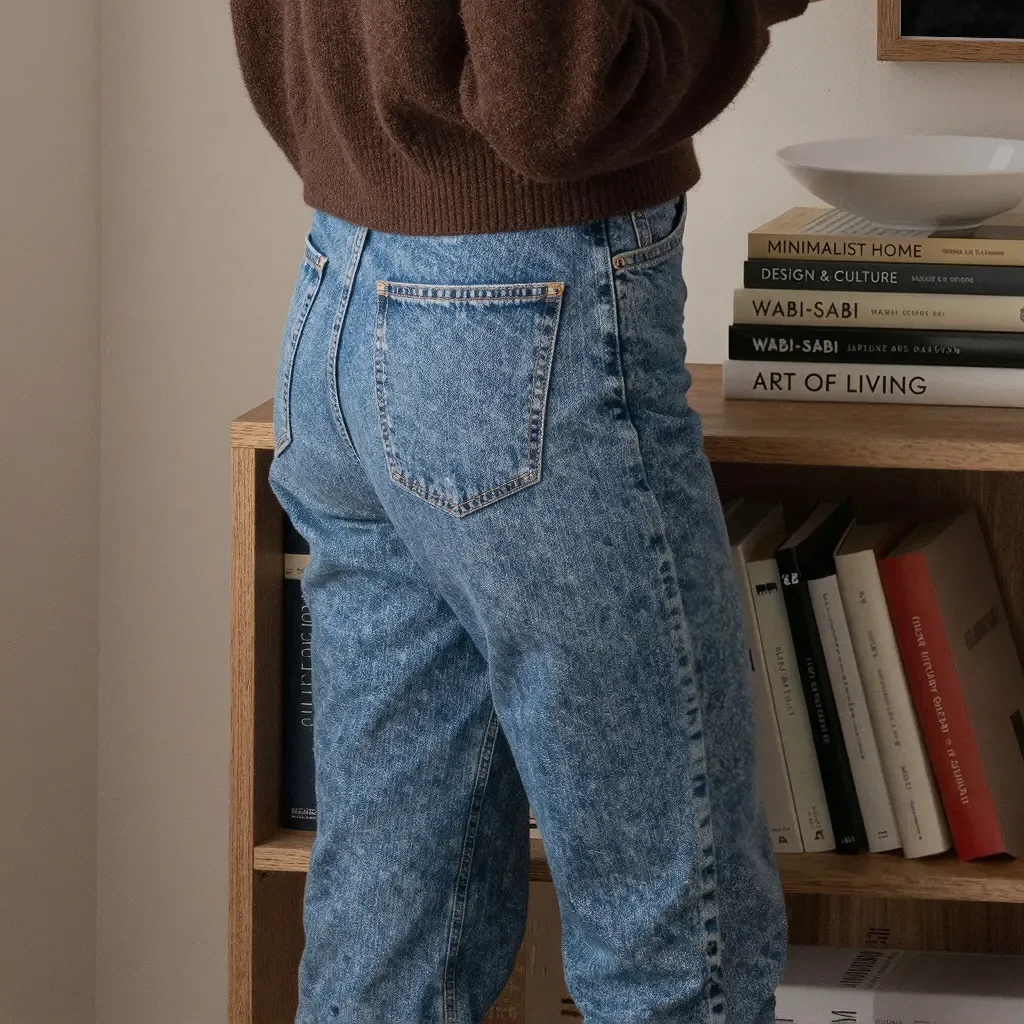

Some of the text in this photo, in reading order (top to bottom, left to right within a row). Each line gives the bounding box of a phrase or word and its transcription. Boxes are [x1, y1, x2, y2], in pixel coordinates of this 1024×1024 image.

[768, 240, 921, 257] MINIMALIST HOME
[762, 268, 897, 283] DESIGN & CULTURE
[752, 300, 857, 318] WABI-SABI
[753, 338, 837, 353] WABI-SABI
[753, 372, 926, 394] ART OF LIVING
